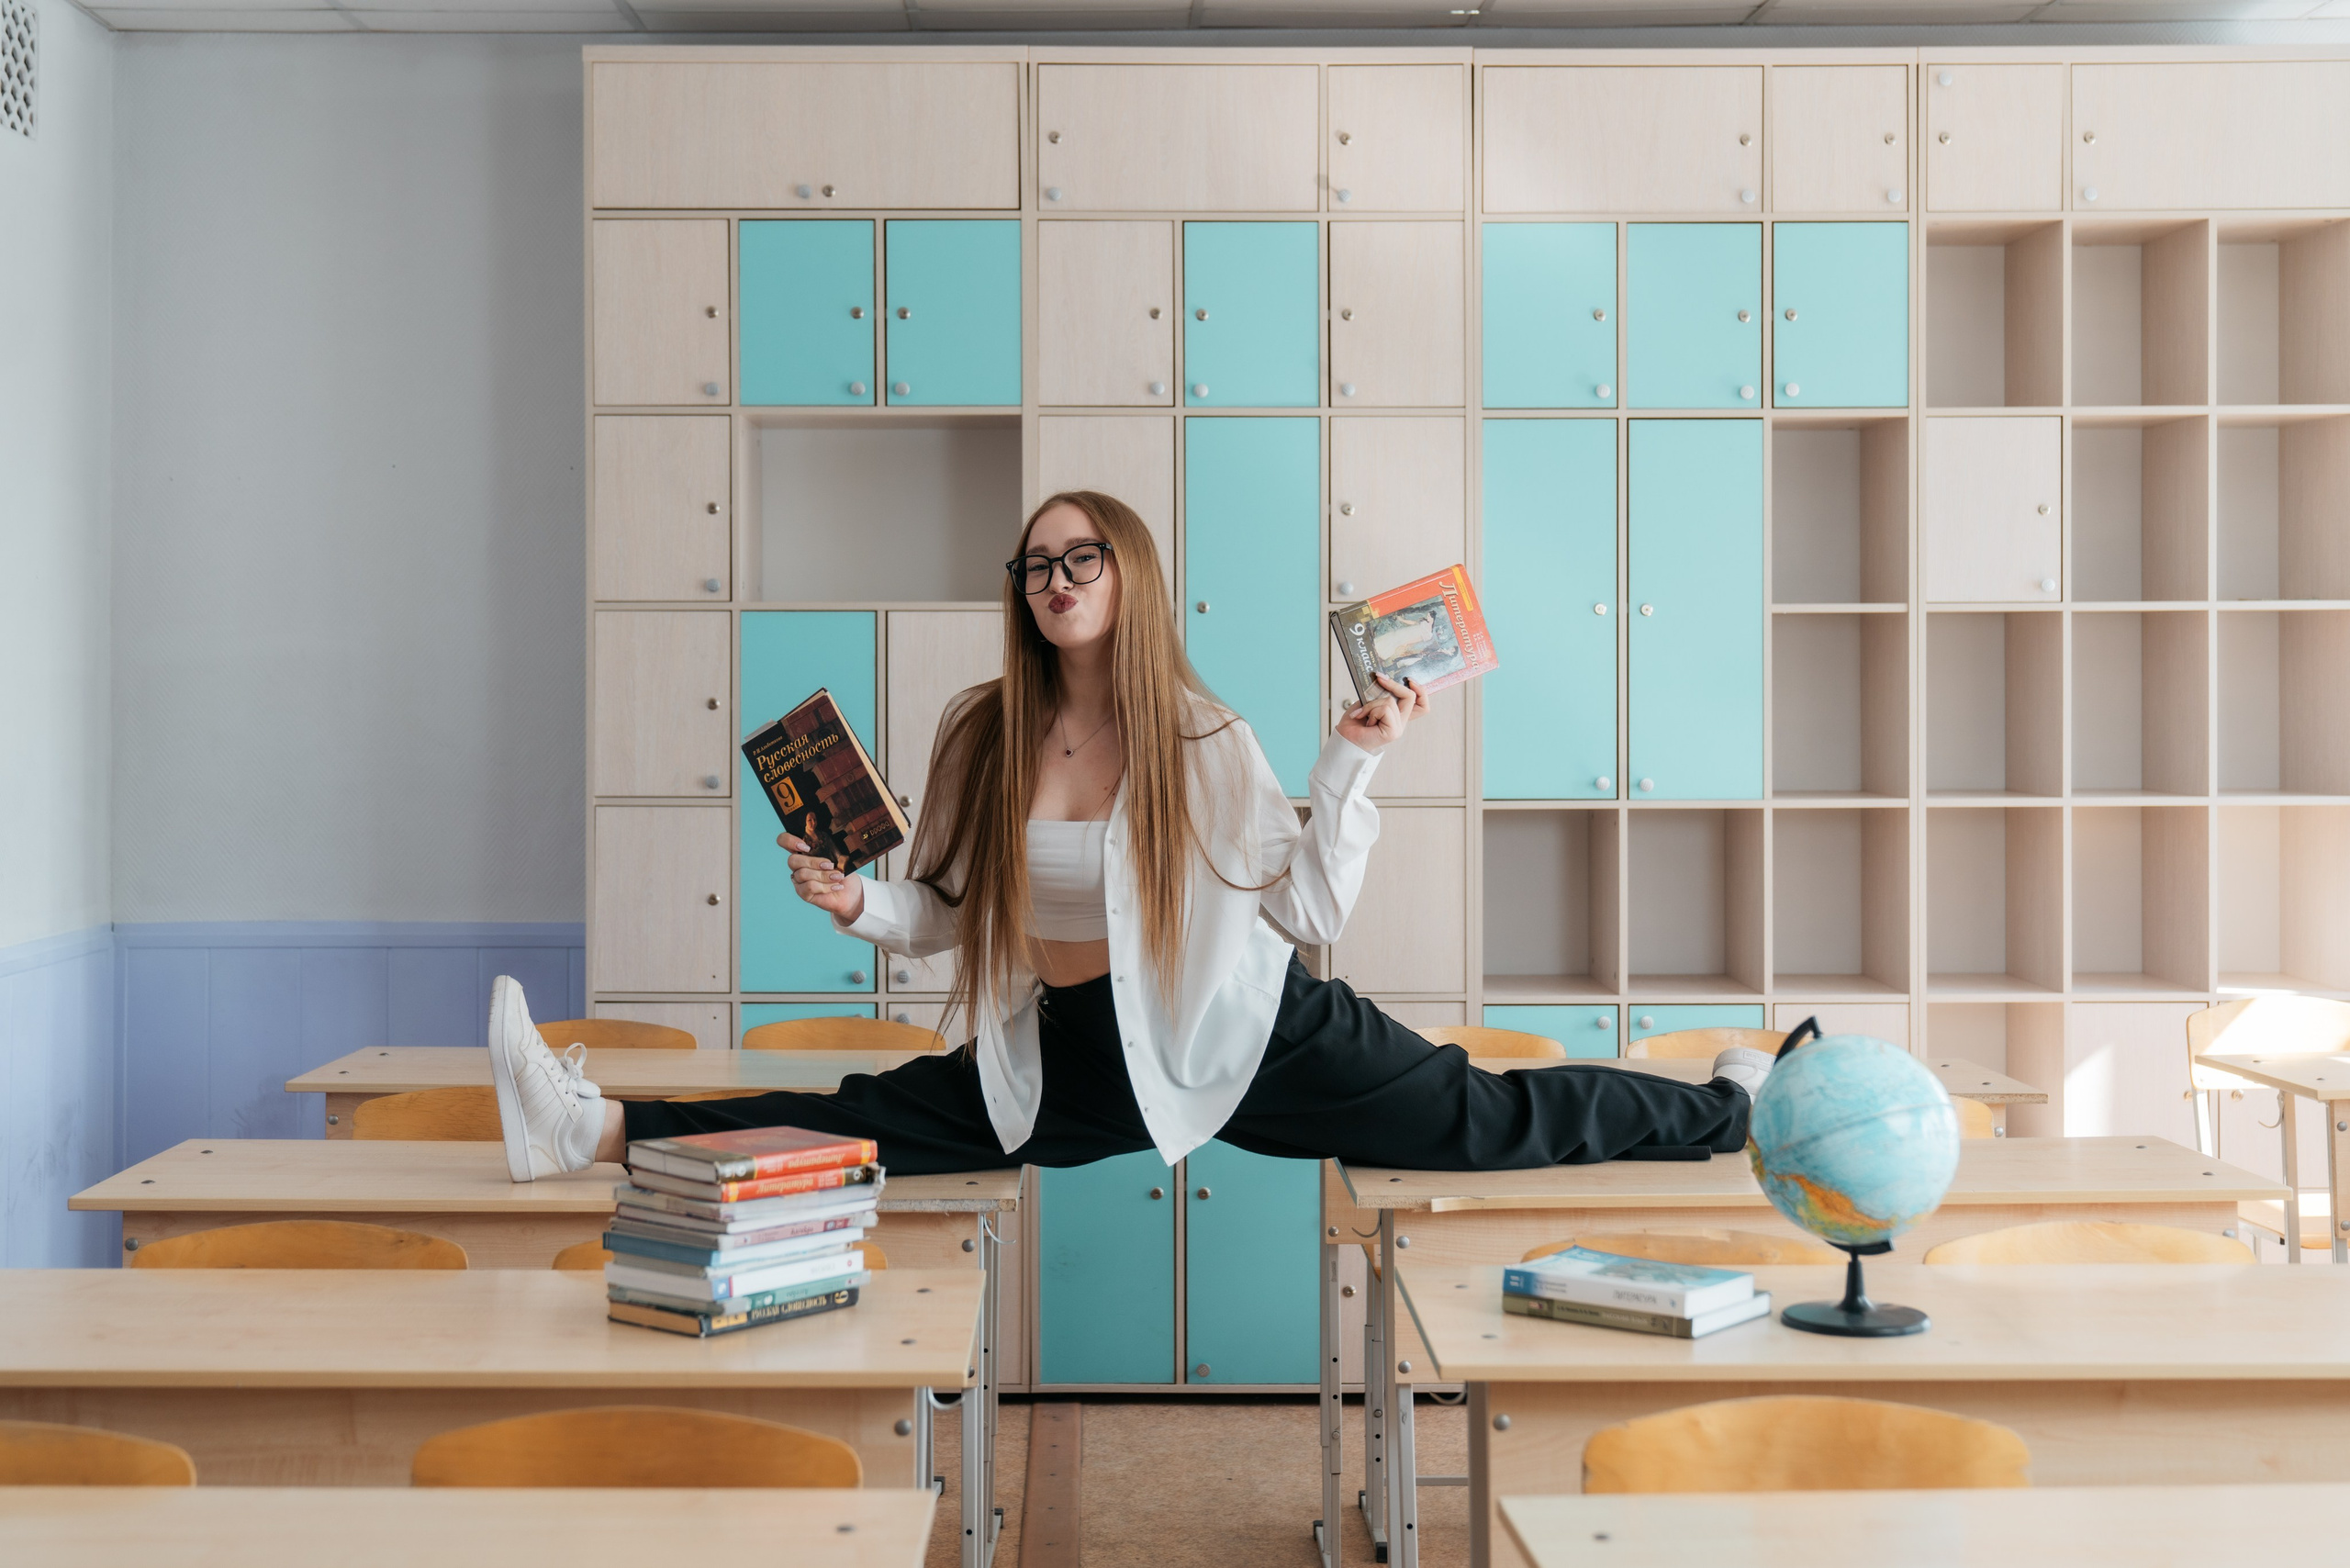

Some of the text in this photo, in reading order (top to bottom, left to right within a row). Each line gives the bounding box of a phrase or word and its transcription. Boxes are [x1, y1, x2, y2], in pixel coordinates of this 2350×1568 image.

[1438, 581, 1480, 669] Литература
[1349, 622, 1373, 672] 9 класс
[756, 734, 809, 771] Русская
[764, 734, 839, 783] словесность
[777, 781, 796, 808] 9
[788, 1153, 845, 1169] Литература
[756, 1177, 813, 1194] Литература
